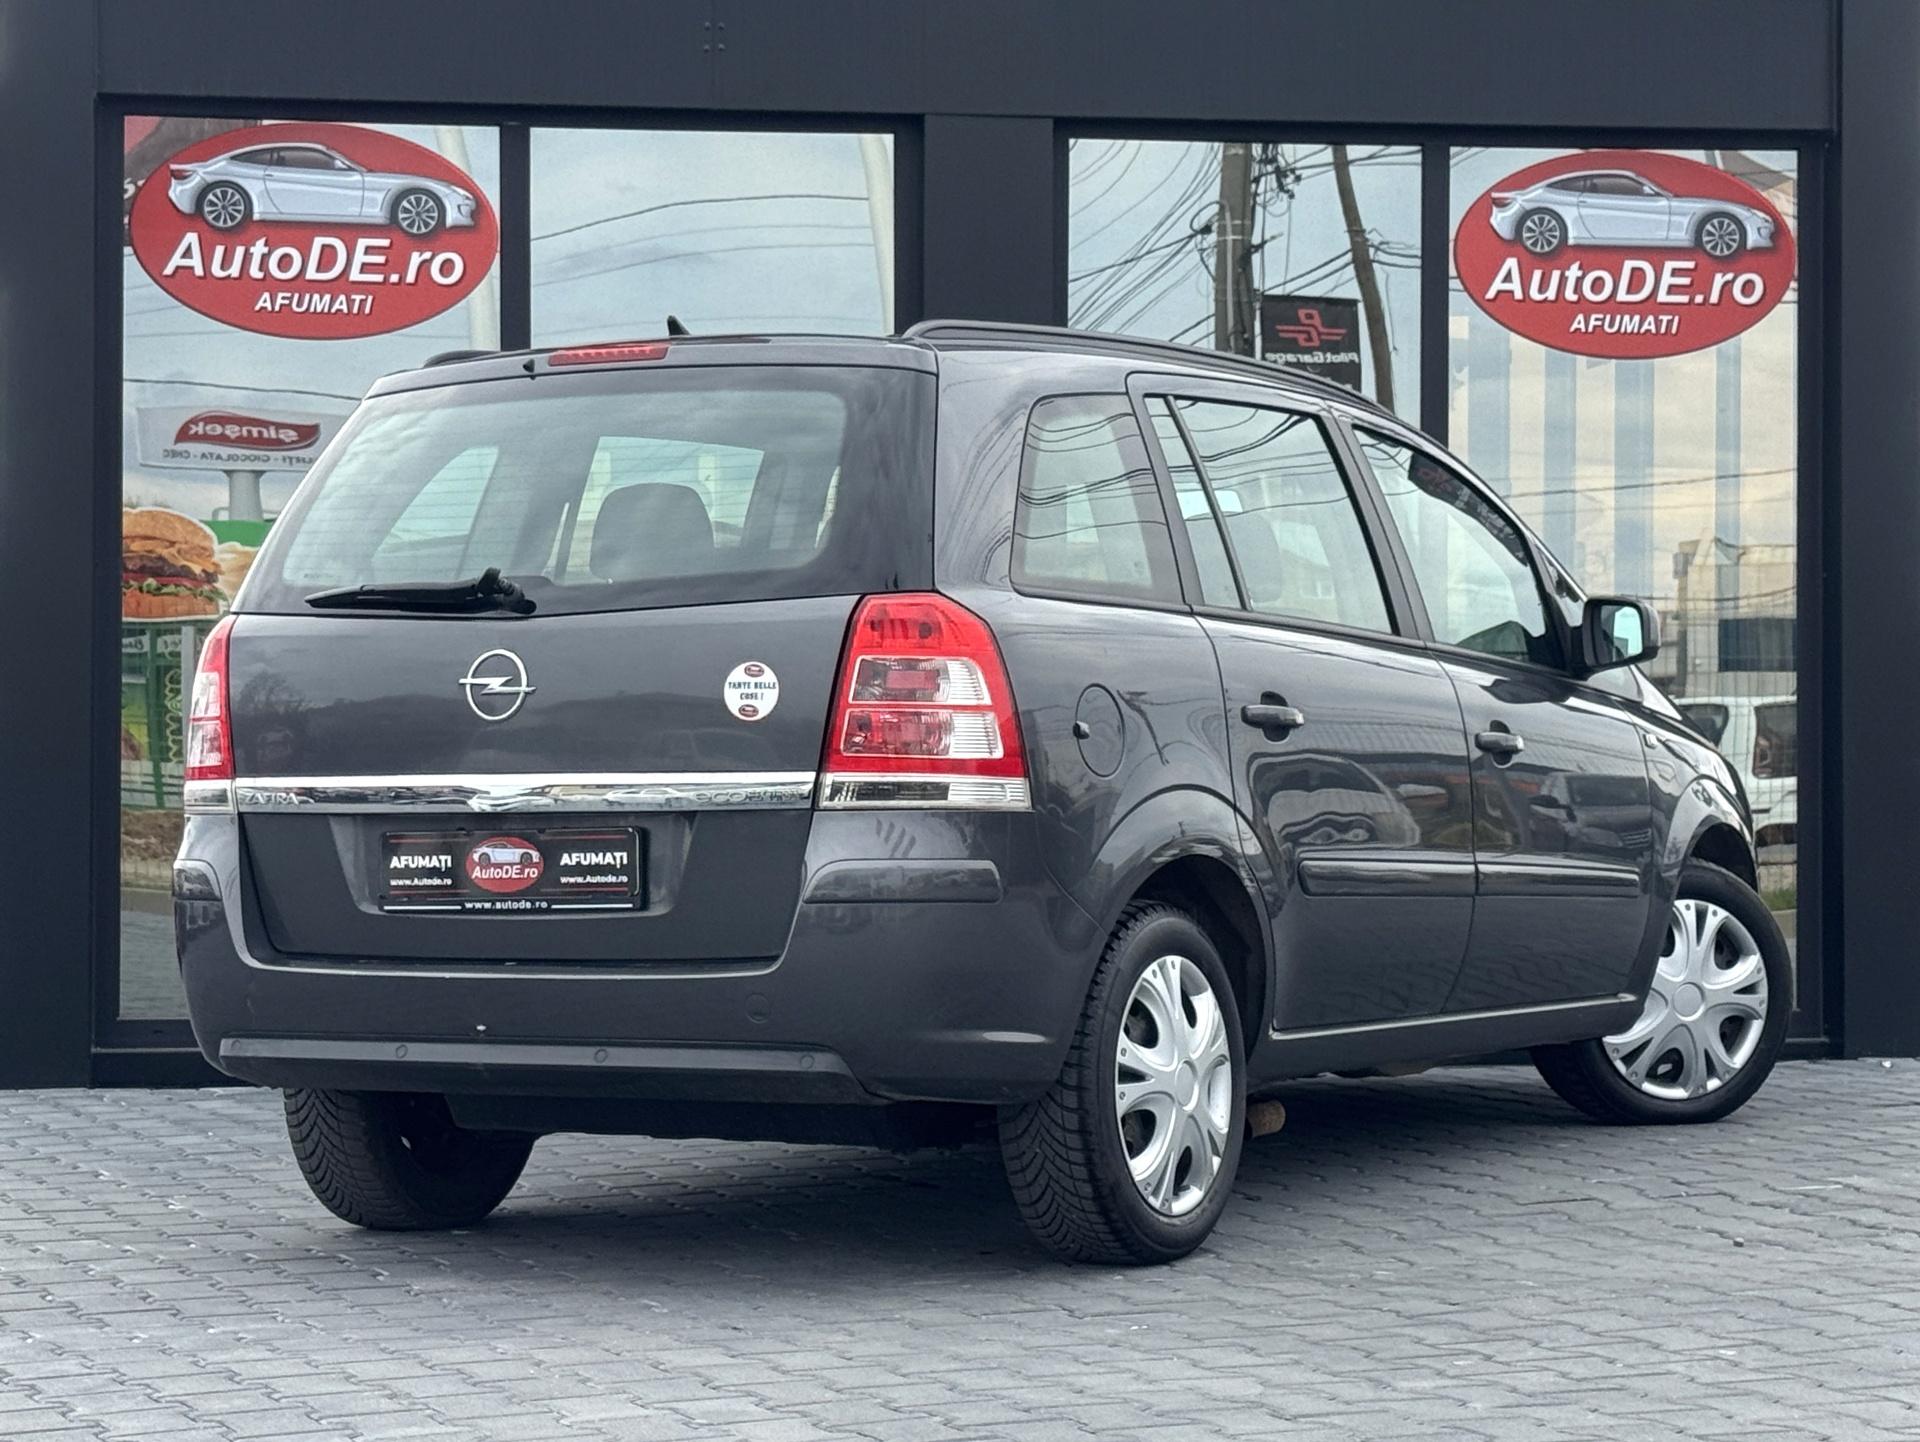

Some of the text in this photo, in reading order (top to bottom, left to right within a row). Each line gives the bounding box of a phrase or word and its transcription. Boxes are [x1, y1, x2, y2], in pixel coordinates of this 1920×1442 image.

[163, 232, 465, 286] AutoDE.ro
[1485, 257, 1766, 306] AutoDE.ro
[254, 292, 374, 316] AFUMATI
[1569, 313, 1681, 335] AFUMATI
[471, 865, 539, 879] AutoDE.ro
[464, 899, 549, 910] www.autode.ro
